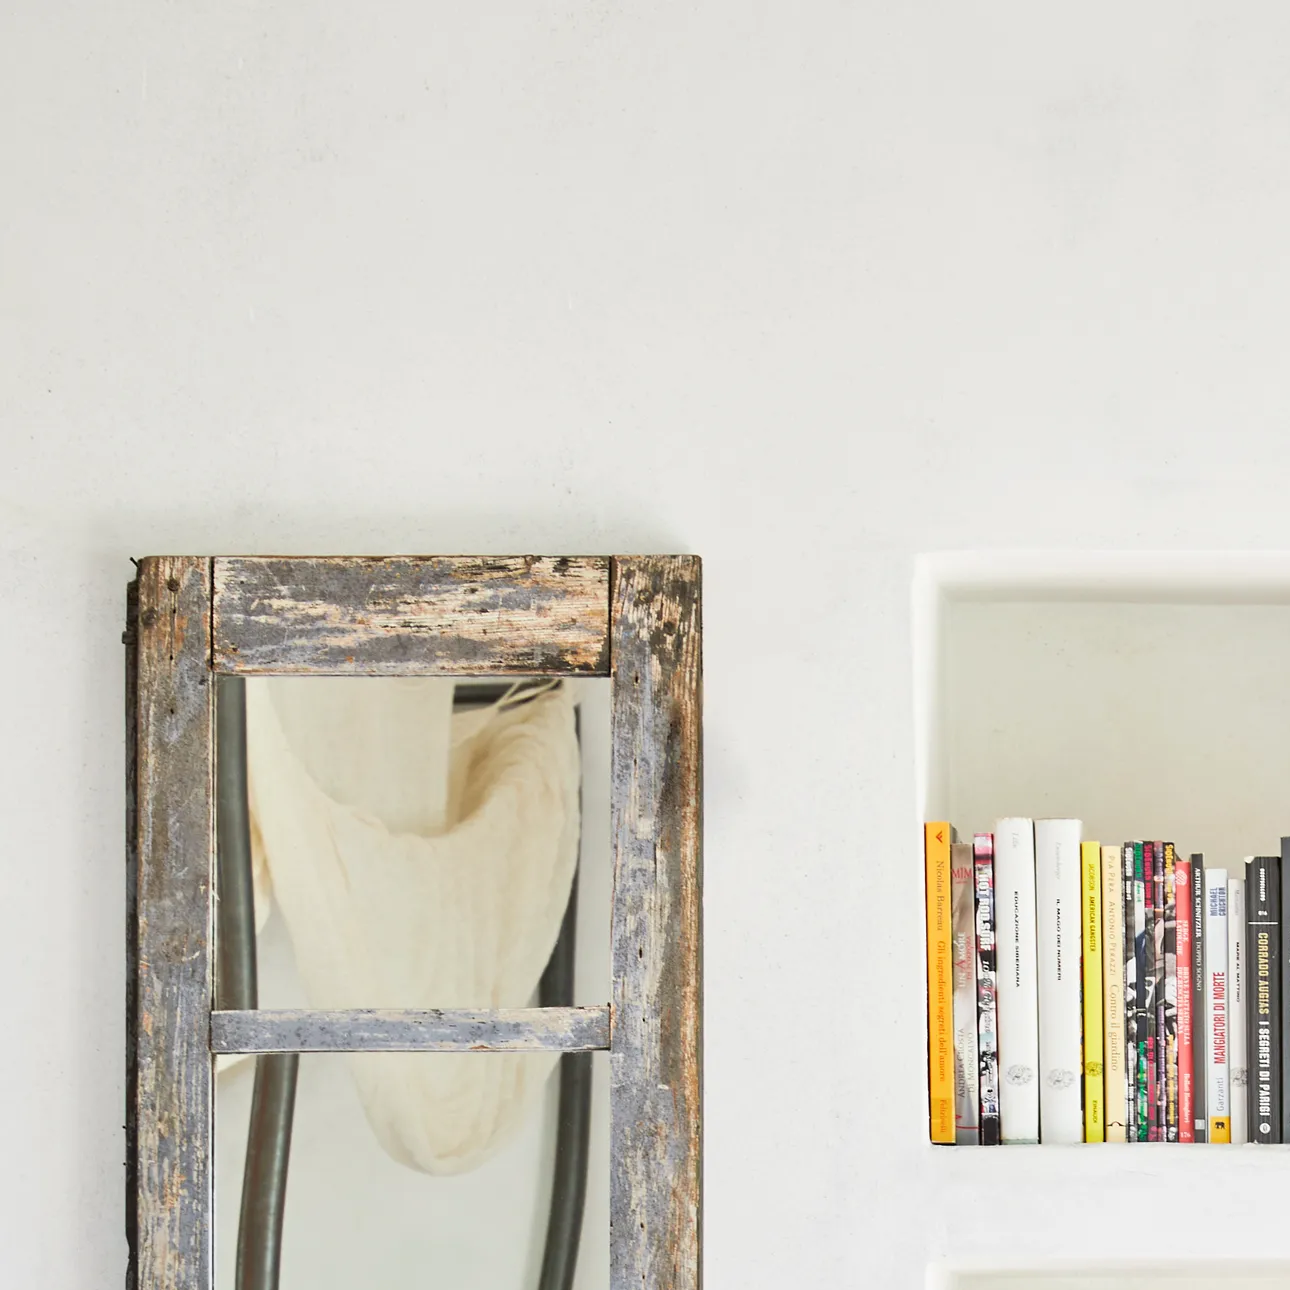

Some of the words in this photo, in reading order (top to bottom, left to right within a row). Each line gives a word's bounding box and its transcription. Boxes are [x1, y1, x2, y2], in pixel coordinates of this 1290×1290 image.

[936, 861, 945, 893] Nicolas
[978, 874, 988, 896] HOT
[937, 895, 945, 931] Barreau
[1210, 887, 1218, 916] MICHAEL
[1218, 887, 1226, 916] CRICHTON
[1108, 901, 1116, 939] ANTONIO
[937, 941, 945, 956] Gli
[1258, 932, 1269, 977] CORRADO
[935, 958, 946, 1004] ingredienti
[1236, 963, 1240, 971] AL
[1109, 985, 1119, 1019] Contro
[1213, 972, 1225, 1000] MORTE
[1258, 980, 1269, 1014] AUGIAS
[936, 1006, 946, 1035] segreti
[1213, 1002, 1225, 1011] DI
[1108, 1032, 1119, 1072] giardino
[1213, 1014, 1225, 1064] MANGIATORI
[1258, 1028, 1270, 1068] SEGRETI
[938, 1037, 947, 1082] dell'amore
[1259, 1071, 1270, 1081] DI
[1215, 1077, 1224, 1111] Garzanti
[1259, 1084, 1270, 1116] PARIGI
